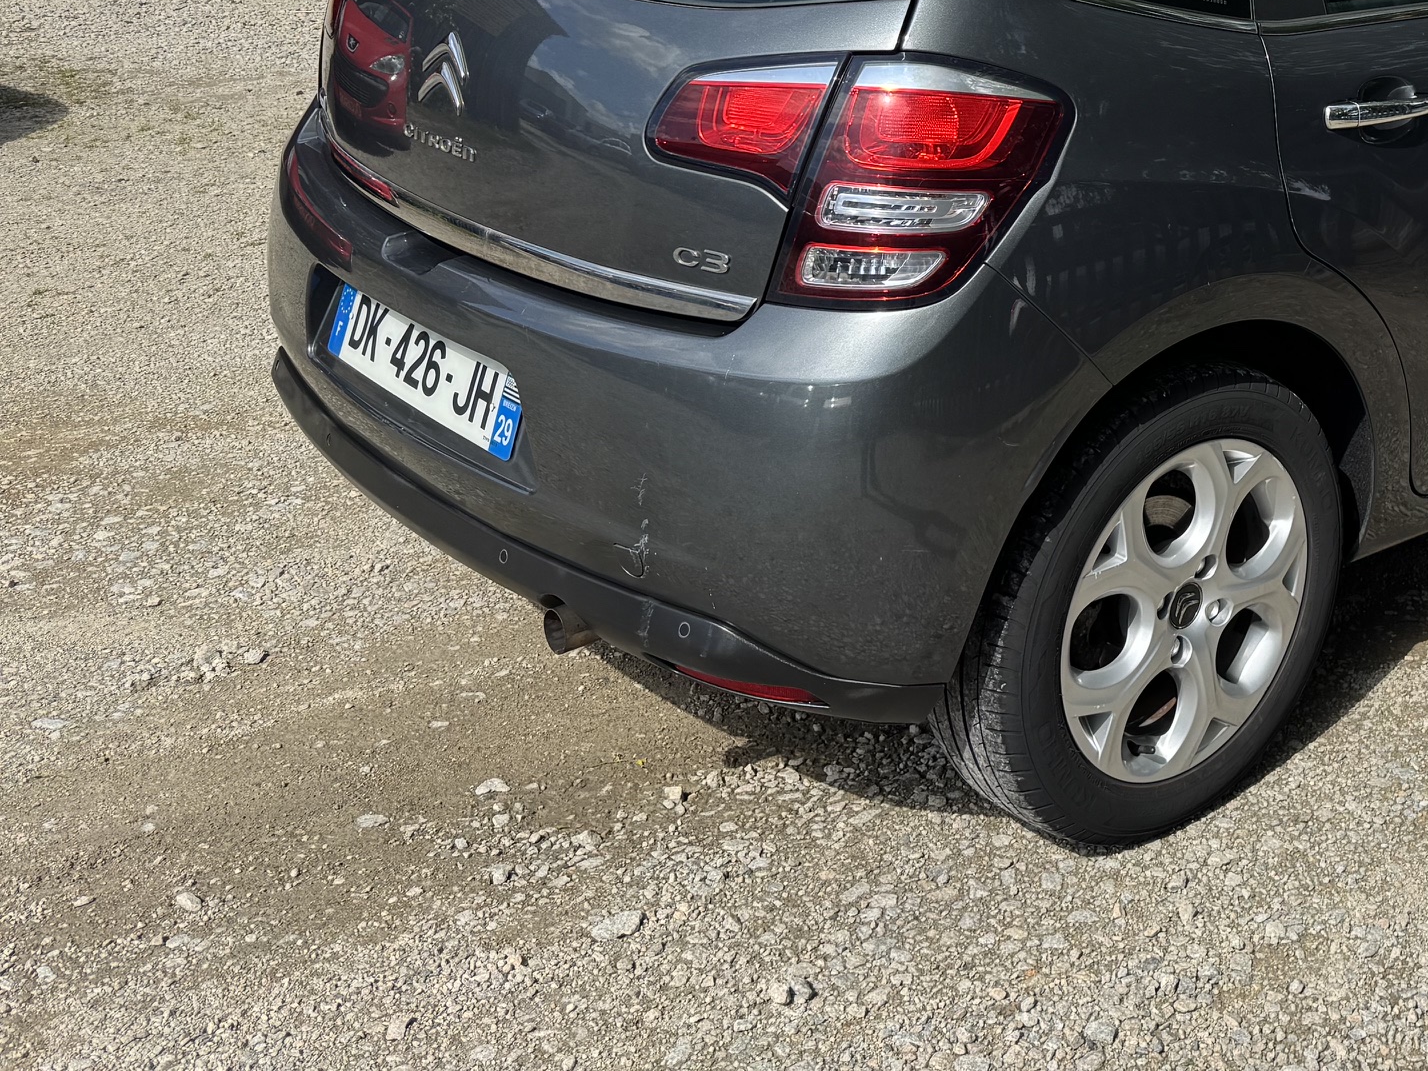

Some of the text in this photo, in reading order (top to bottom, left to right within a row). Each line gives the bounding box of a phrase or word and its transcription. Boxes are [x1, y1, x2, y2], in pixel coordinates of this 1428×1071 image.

[672, 246, 732, 275] C3
[335, 321, 344, 336] F
[493, 414, 514, 446] 29
